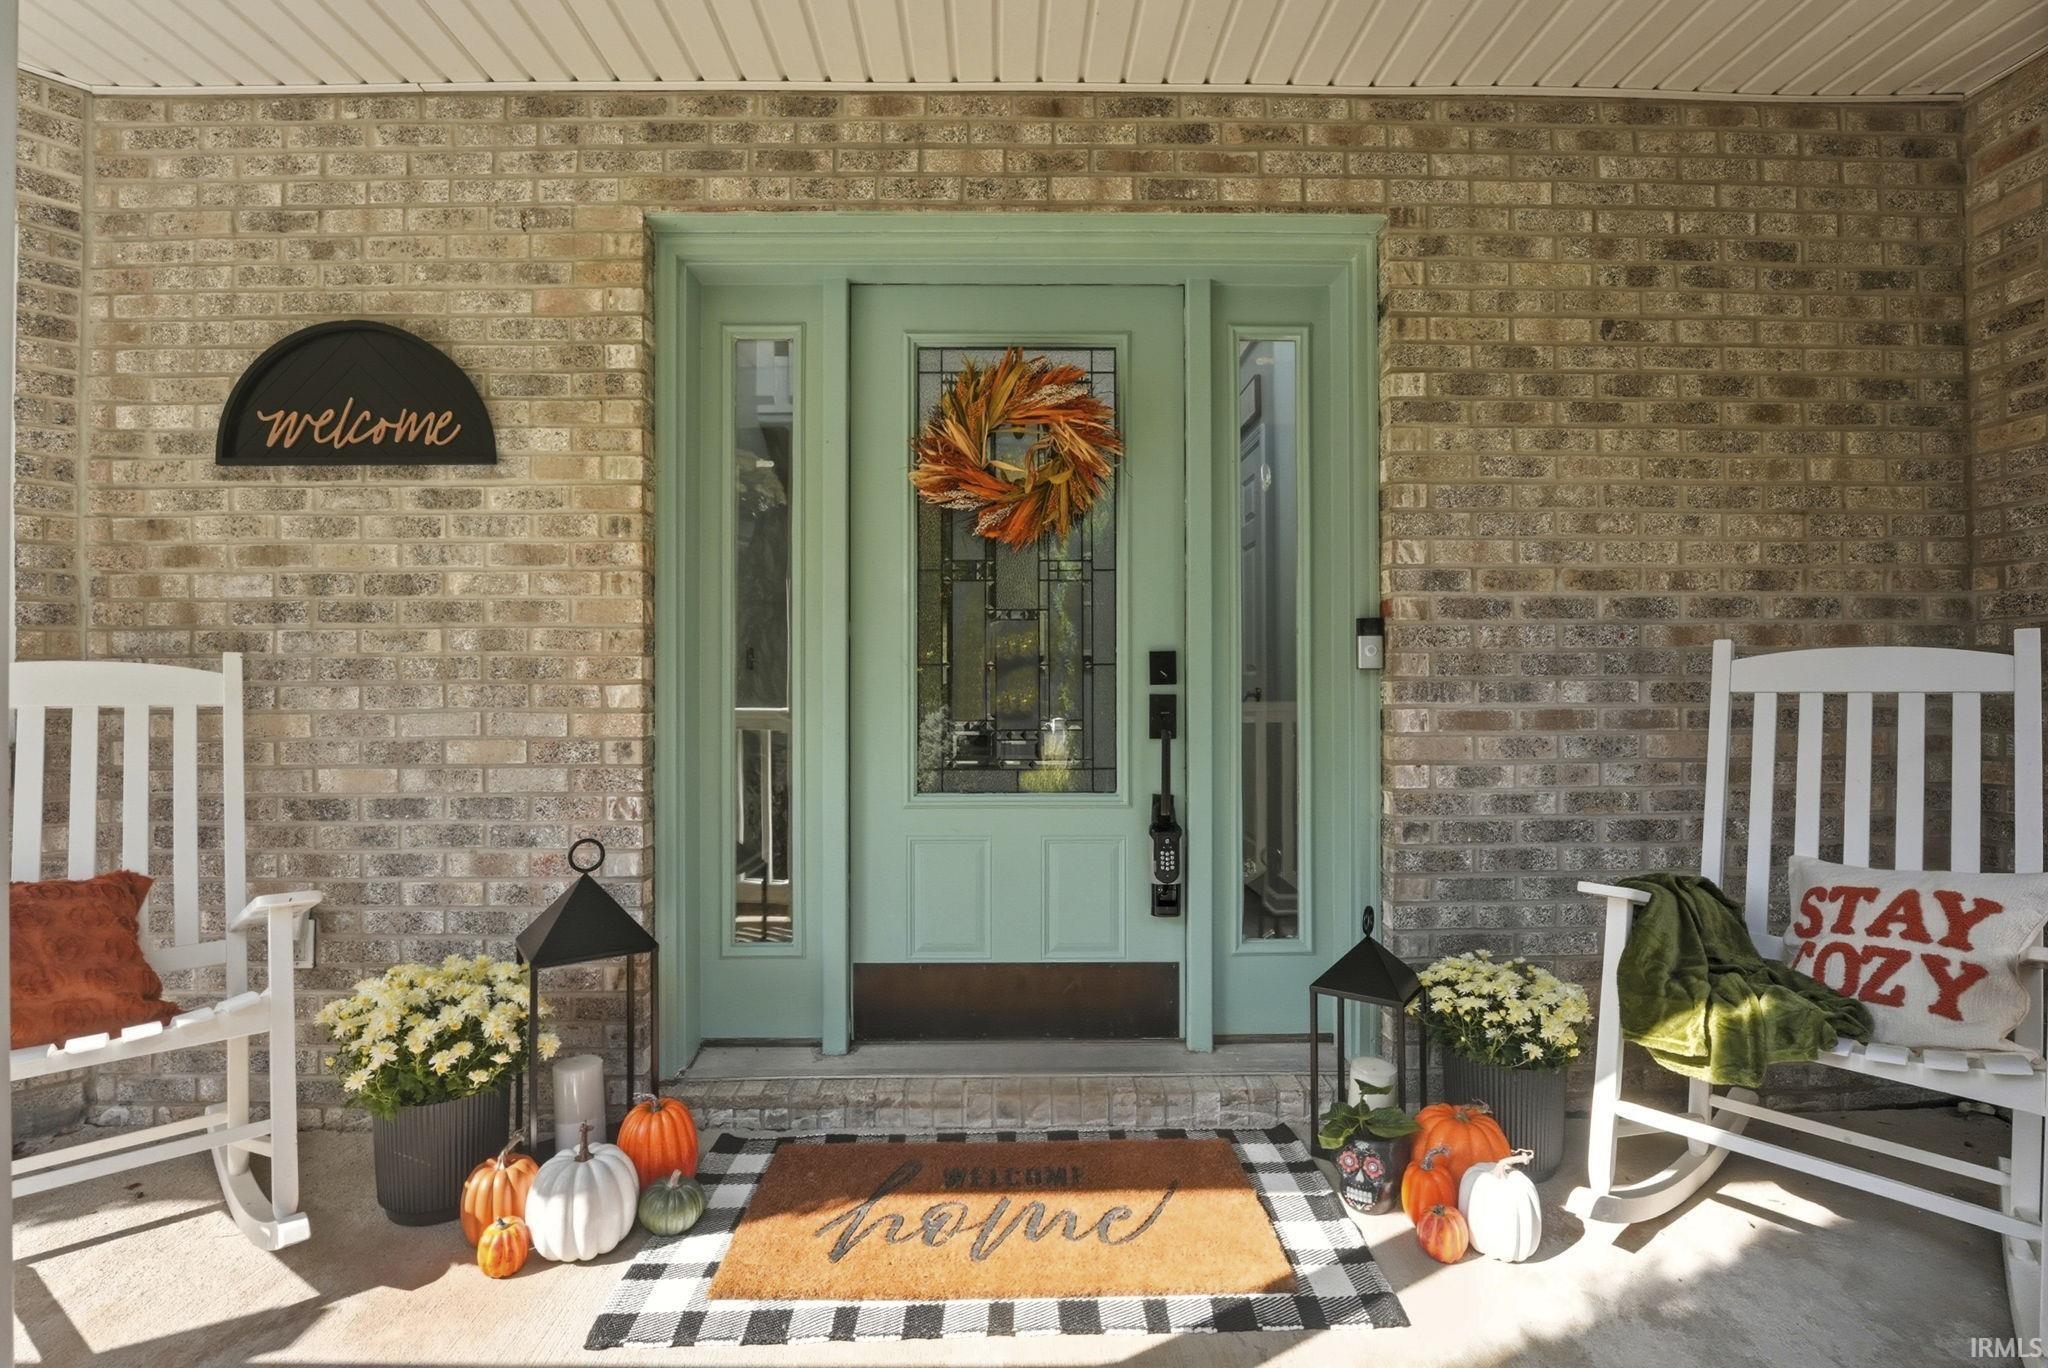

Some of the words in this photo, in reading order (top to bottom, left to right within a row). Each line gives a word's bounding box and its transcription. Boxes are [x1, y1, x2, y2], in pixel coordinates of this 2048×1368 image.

[257, 397, 461, 449] welcome
[1793, 885, 2004, 952] STAY
[943, 1166, 1085, 1188] WELCOME
[815, 1159, 1182, 1264] home
